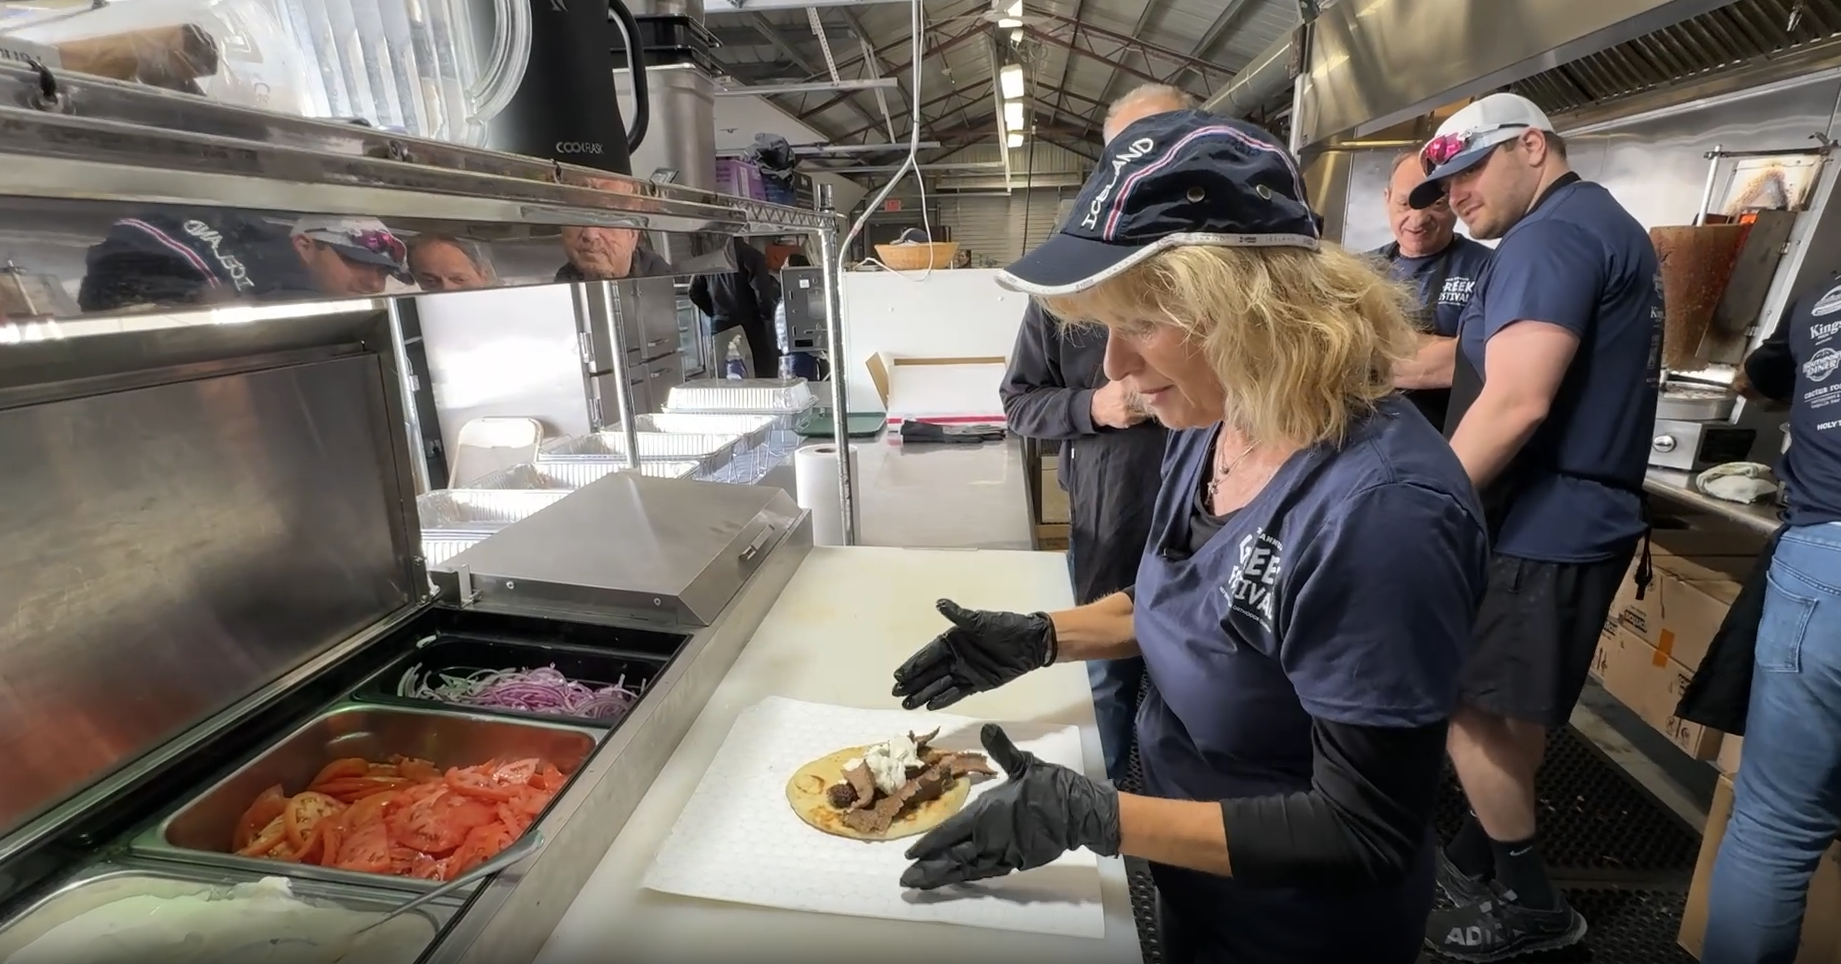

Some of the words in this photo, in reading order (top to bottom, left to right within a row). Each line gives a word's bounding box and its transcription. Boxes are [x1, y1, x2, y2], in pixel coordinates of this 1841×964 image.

[1081, 138, 1154, 230] ICELAND
[1442, 280, 1475, 293] REEK
[1830, 383, 1841, 392] ro
[1259, 533, 1283, 551] ANNU
[1239, 533, 1281, 585] GEE
